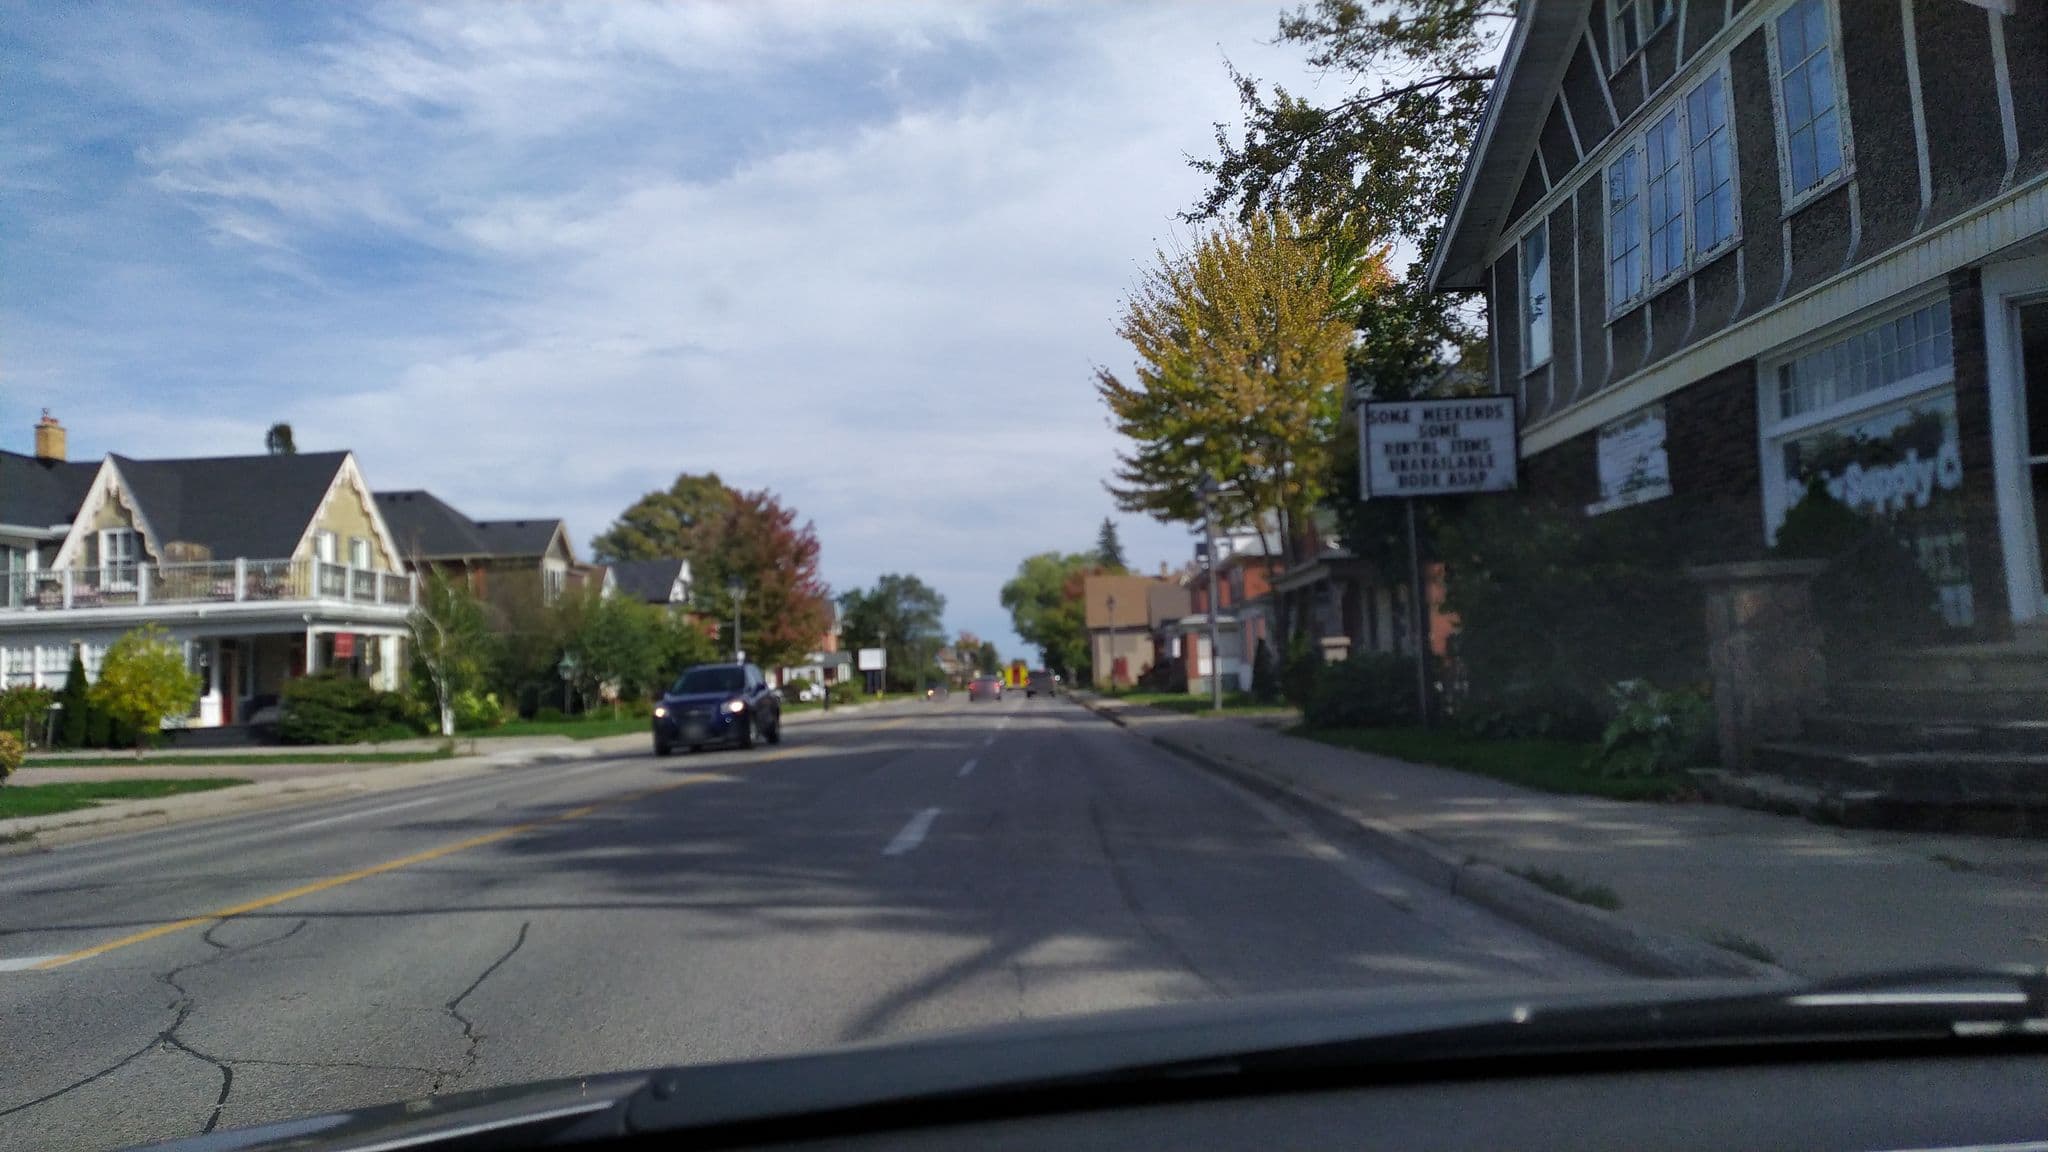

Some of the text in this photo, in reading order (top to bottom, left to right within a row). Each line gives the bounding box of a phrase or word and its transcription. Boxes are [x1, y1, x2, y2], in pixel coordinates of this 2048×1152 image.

[1368, 404, 1504, 425] SOME WEEKENDS
[1419, 424, 1460, 438] SOME
